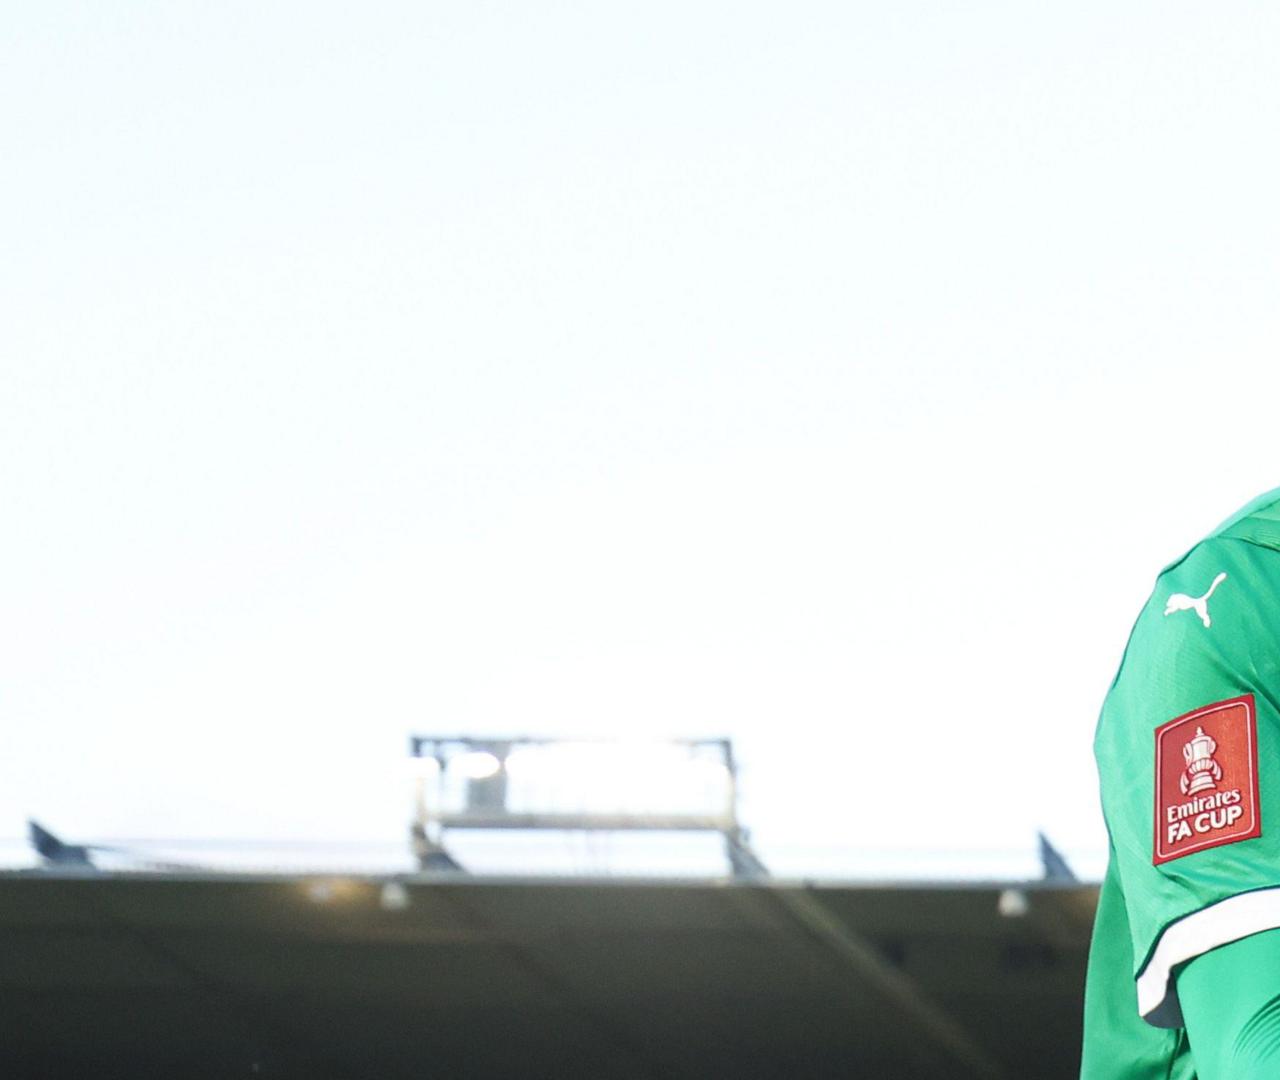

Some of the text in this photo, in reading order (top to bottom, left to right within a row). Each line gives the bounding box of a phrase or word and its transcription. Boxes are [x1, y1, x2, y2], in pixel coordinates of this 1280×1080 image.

[1167, 790, 1241, 822] Emirates
[1168, 806, 1242, 844] FA CUP
